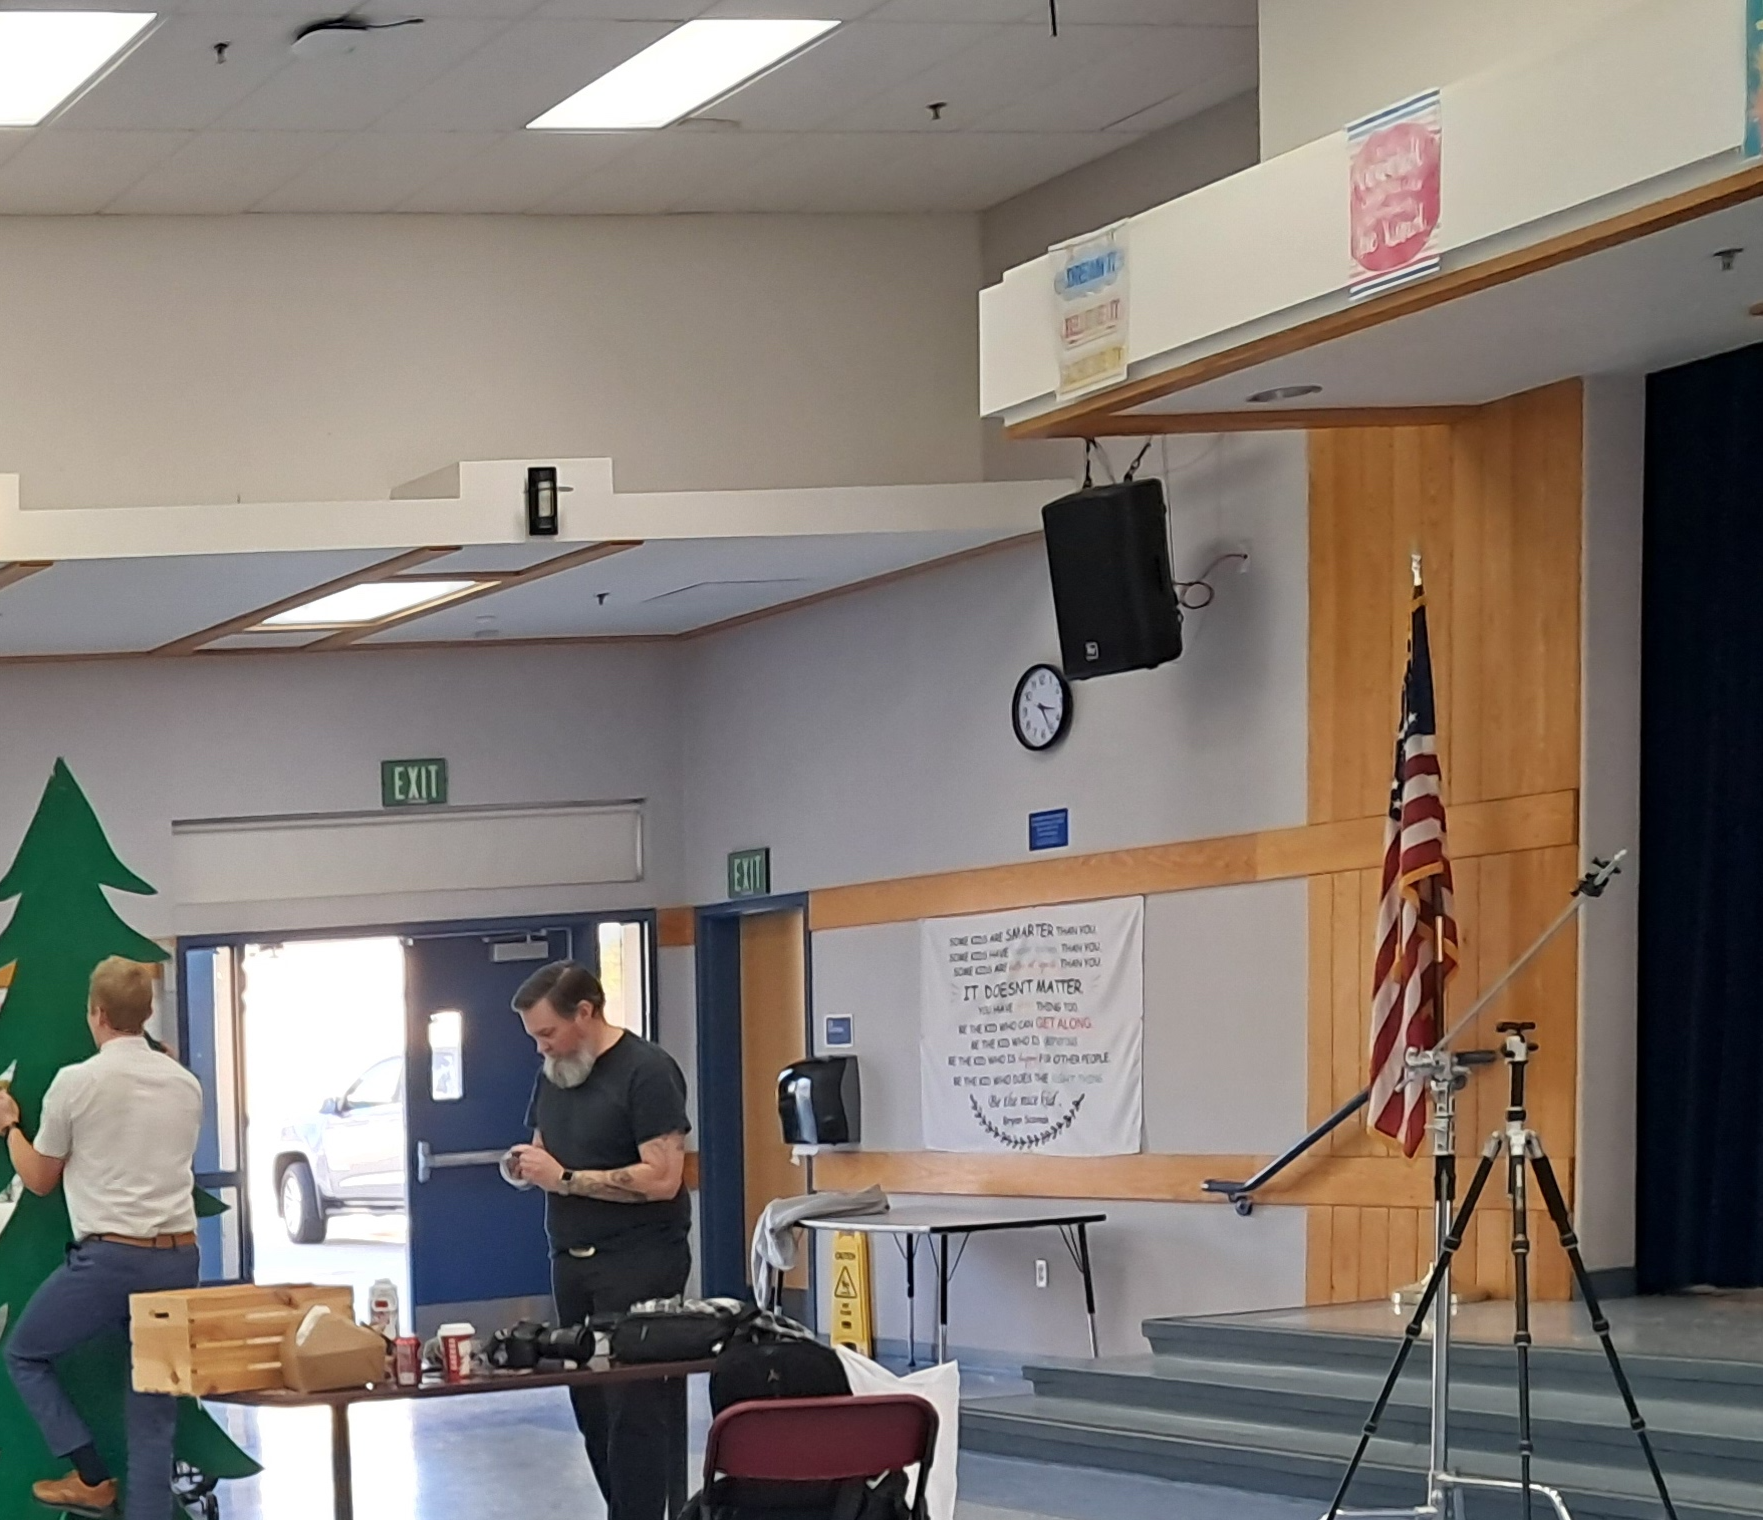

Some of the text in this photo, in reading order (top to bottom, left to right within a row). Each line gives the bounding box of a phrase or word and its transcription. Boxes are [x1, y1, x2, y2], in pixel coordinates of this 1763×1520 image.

[394, 765, 439, 800] EXIT
[734, 855, 761, 892] EXIT
[1005, 923, 1054, 942] SMARTER
[1056, 925, 1077, 936] THAN
[1061, 943, 1083, 953] THAN
[1060, 959, 1083, 968] THAN
[963, 985, 979, 1001] IT
[1036, 1016, 1055, 1029] GET
